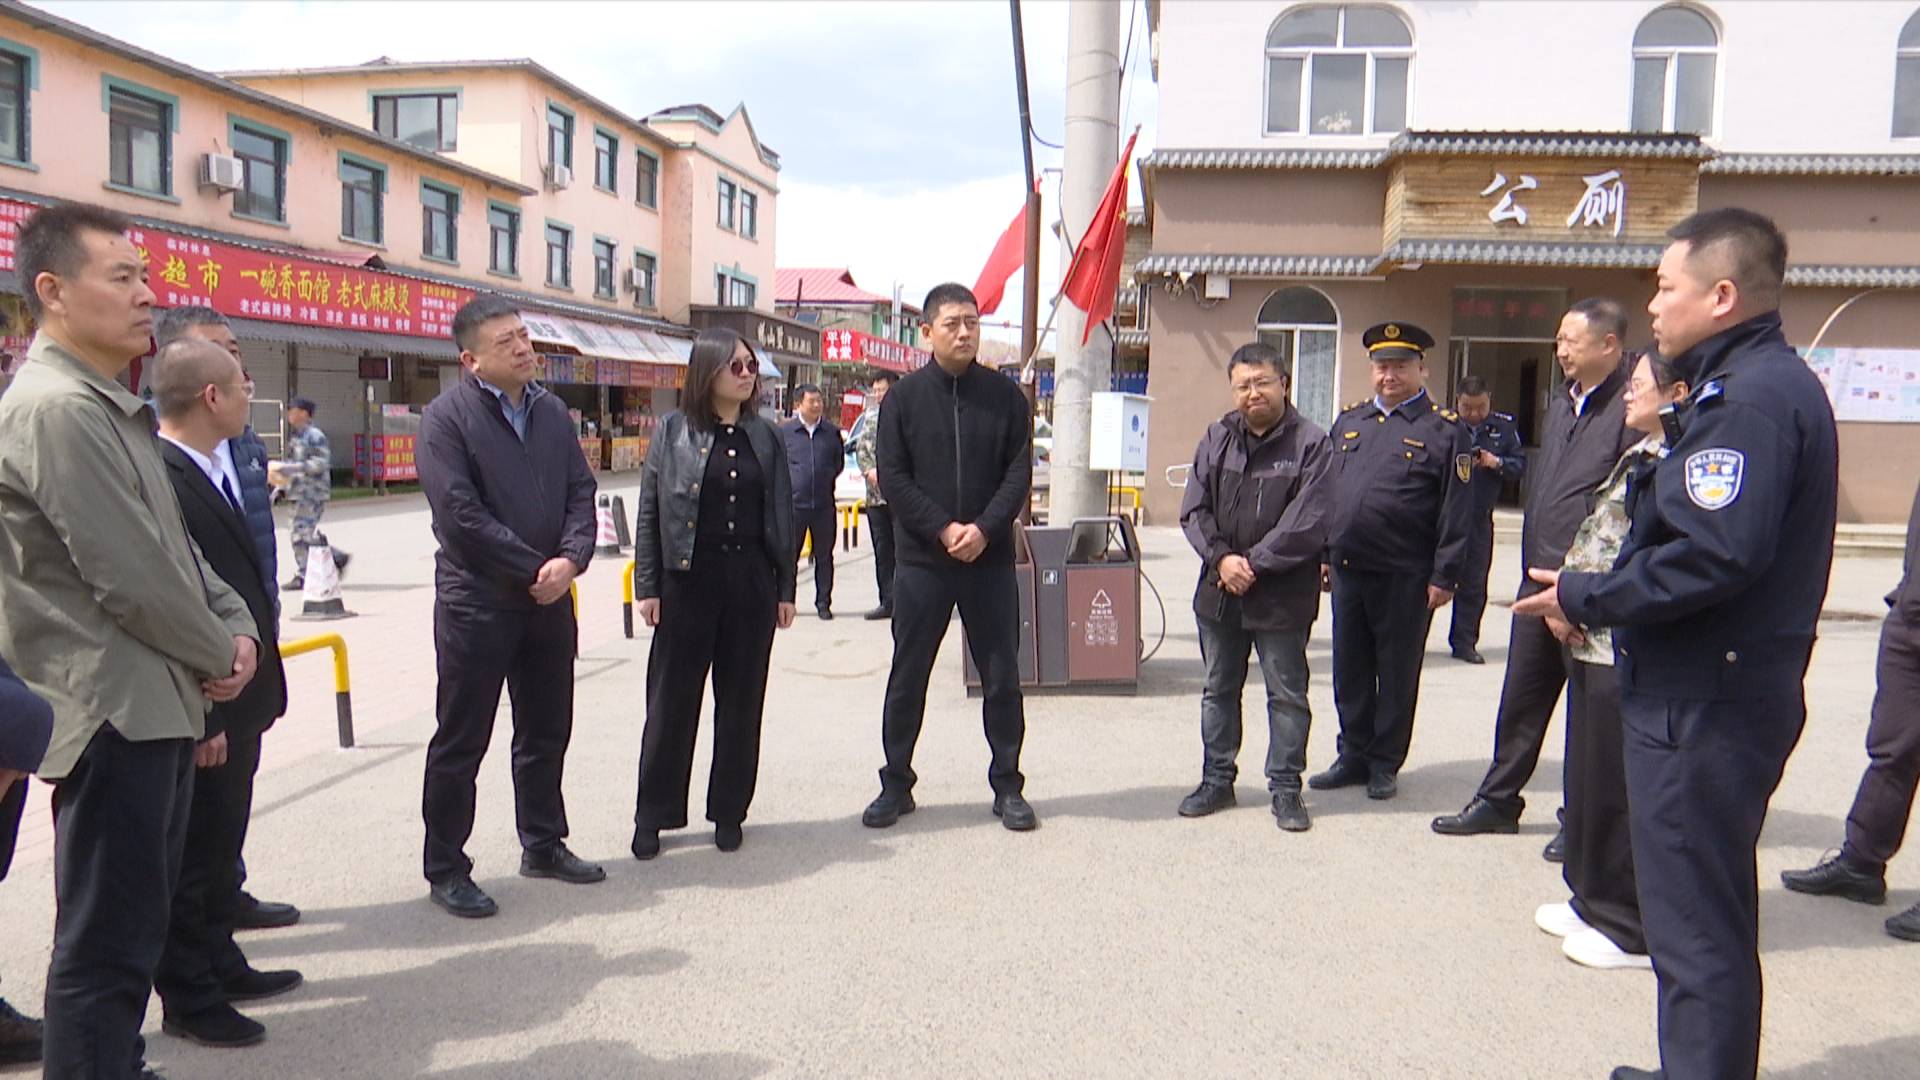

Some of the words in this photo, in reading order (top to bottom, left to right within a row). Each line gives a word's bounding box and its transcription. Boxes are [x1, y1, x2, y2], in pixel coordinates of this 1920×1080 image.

[1480, 169, 1625, 238] 公厕
[240, 261, 331, 305] 一碗香面馆
[336, 271, 410, 316] 老式麻辣烫
